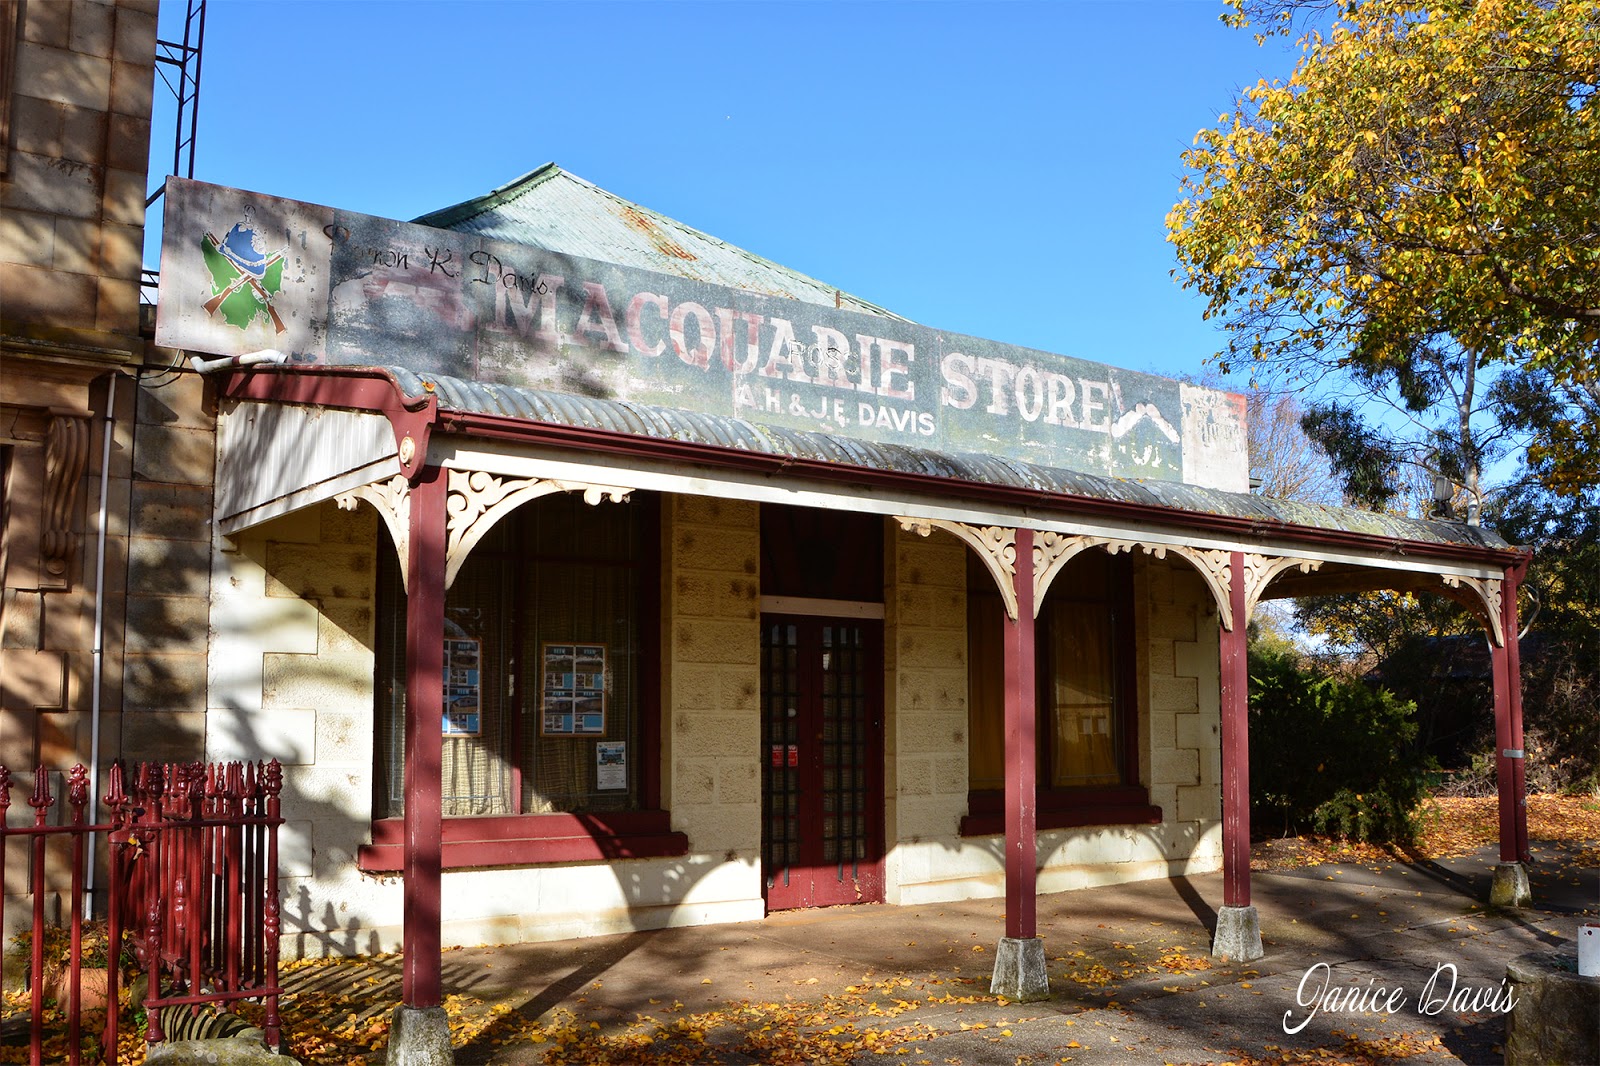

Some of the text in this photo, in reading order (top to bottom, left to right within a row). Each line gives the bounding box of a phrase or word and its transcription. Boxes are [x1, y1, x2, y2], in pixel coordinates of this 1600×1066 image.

[485, 267, 1111, 434] MACQUARIE STORE
[788, 393, 811, 418] &
[858, 402, 936, 436] DAVIS
